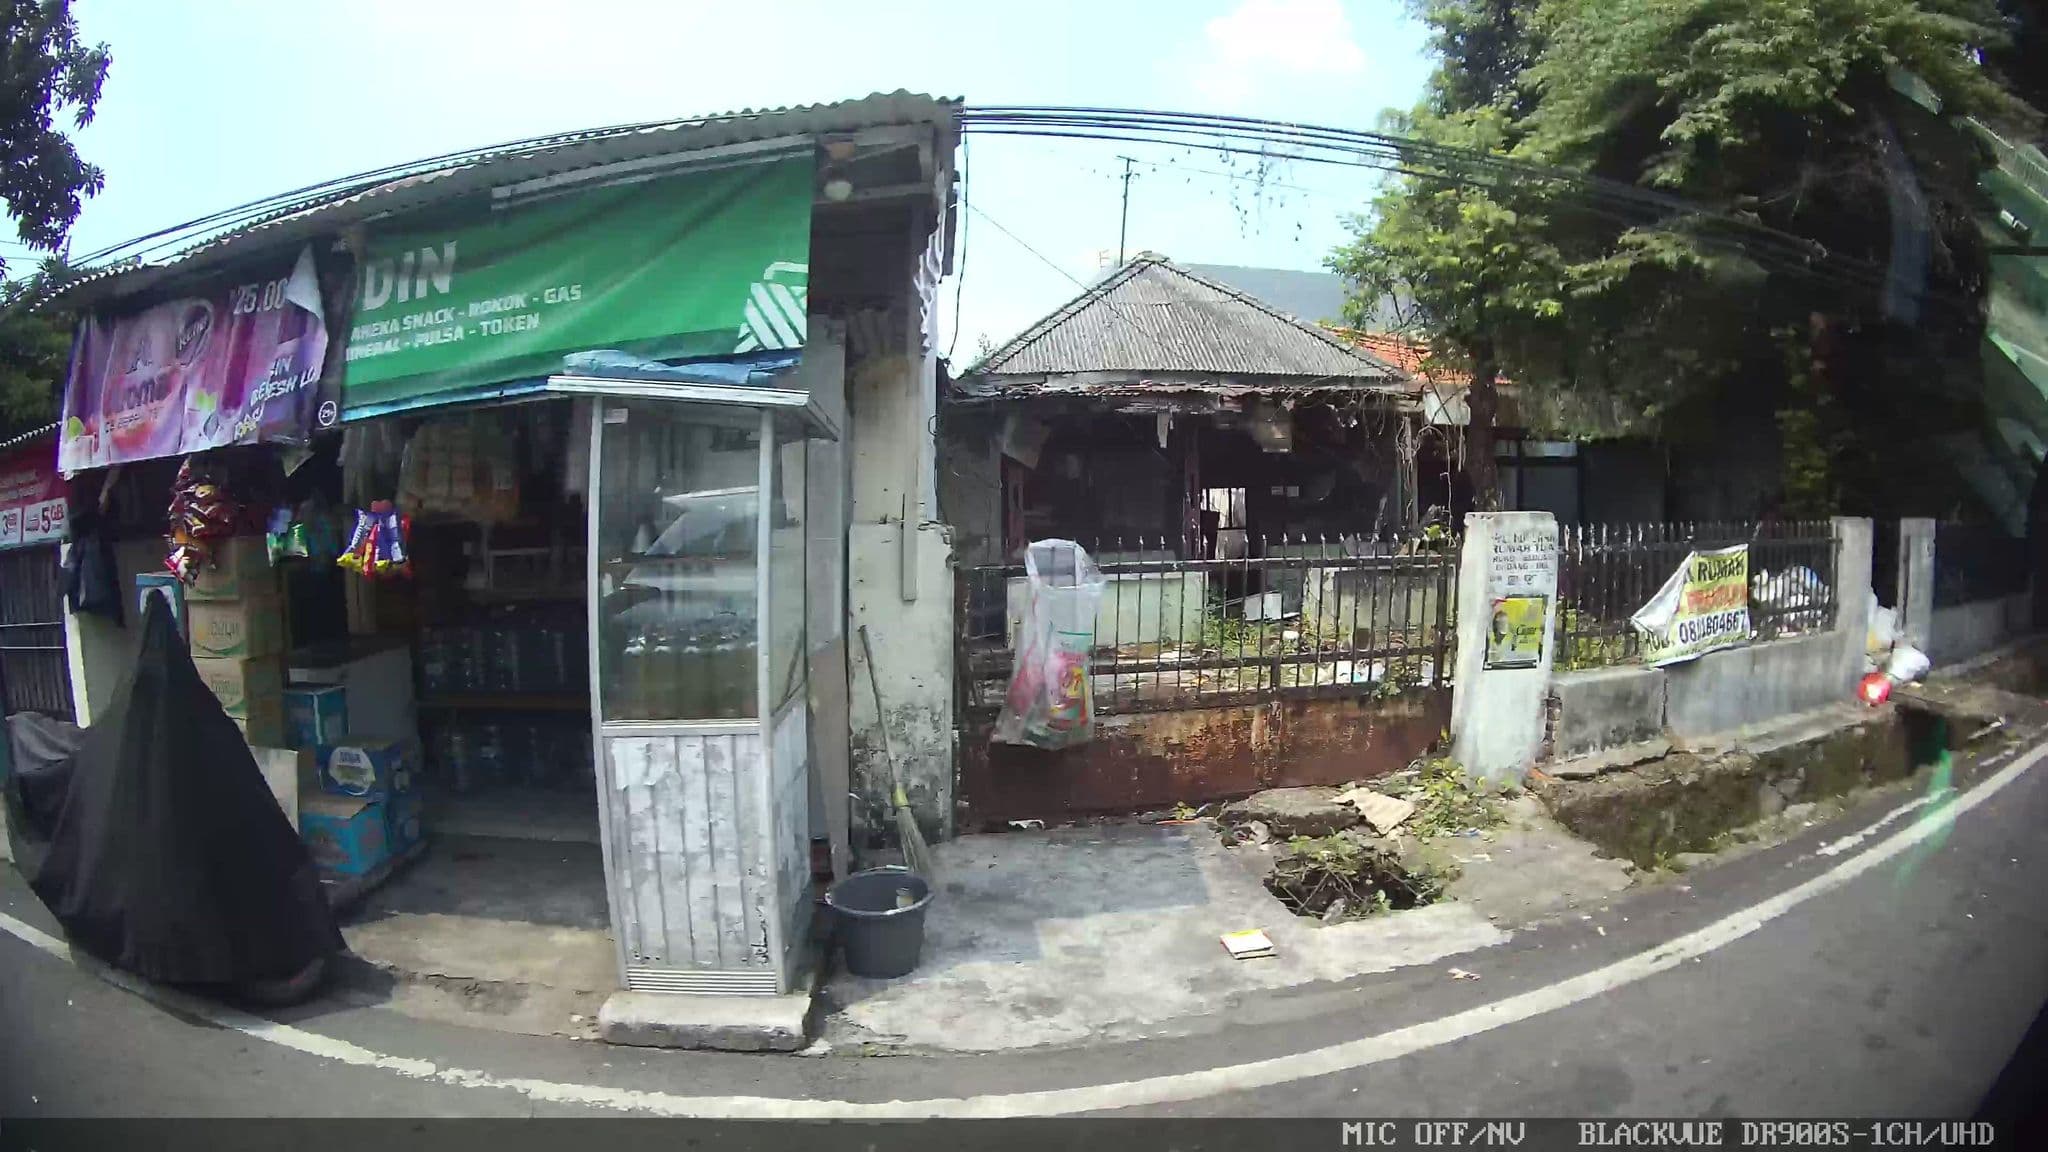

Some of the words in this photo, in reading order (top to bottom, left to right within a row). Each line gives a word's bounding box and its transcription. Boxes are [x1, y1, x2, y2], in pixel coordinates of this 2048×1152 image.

[402, 307, 456, 331] SNACK
[468, 291, 528, 318] ROKOK
[543, 284, 582, 304] GAS
[415, 326, 464, 347] PULSA
[479, 312, 541, 336] TOKEN
